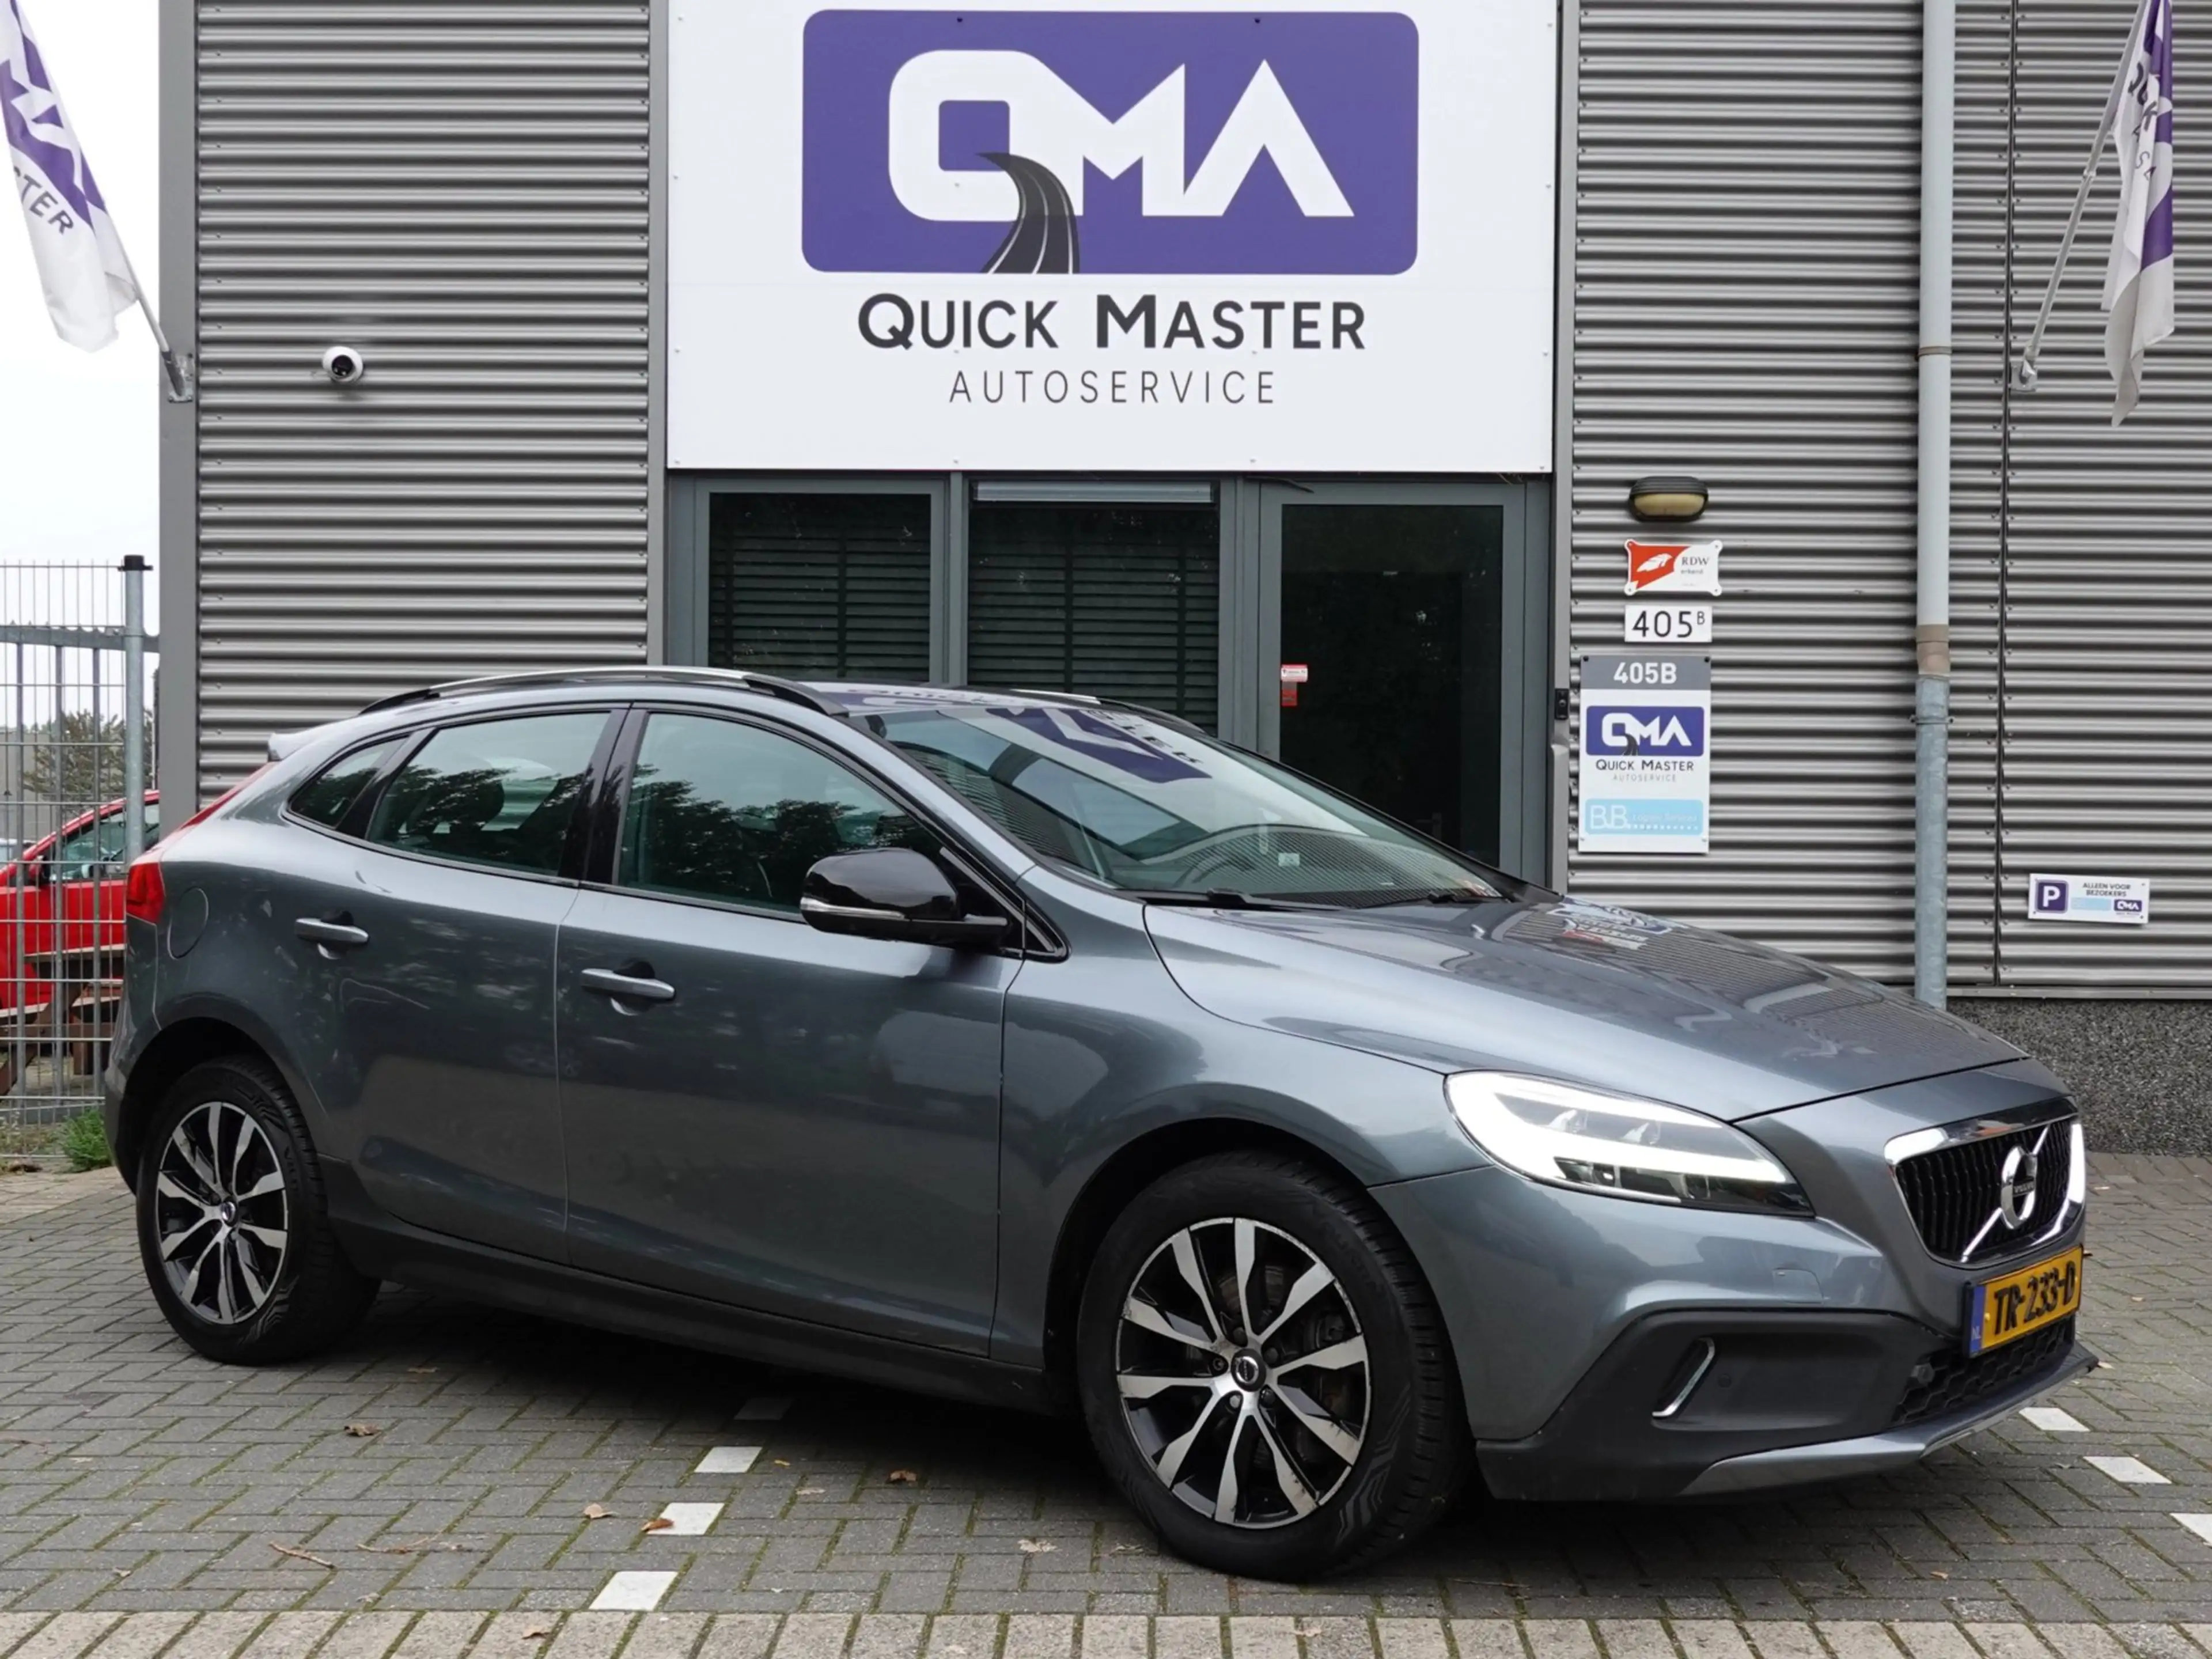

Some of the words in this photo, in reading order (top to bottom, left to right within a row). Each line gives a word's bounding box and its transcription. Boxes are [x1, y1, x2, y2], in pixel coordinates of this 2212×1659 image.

[889, 50, 1355, 274] QMA
[949, 370, 1274, 404] AUTOSERVICE
[1681, 556, 1710, 566] RDW
[1613, 661, 1677, 684] 405B
[1601, 712, 1692, 756] QMA
[1613, 774, 1677, 782] AUTOSERVICE
[2043, 885, 2061, 907] P
[1994, 1260, 2076, 1336] TR-233-D
